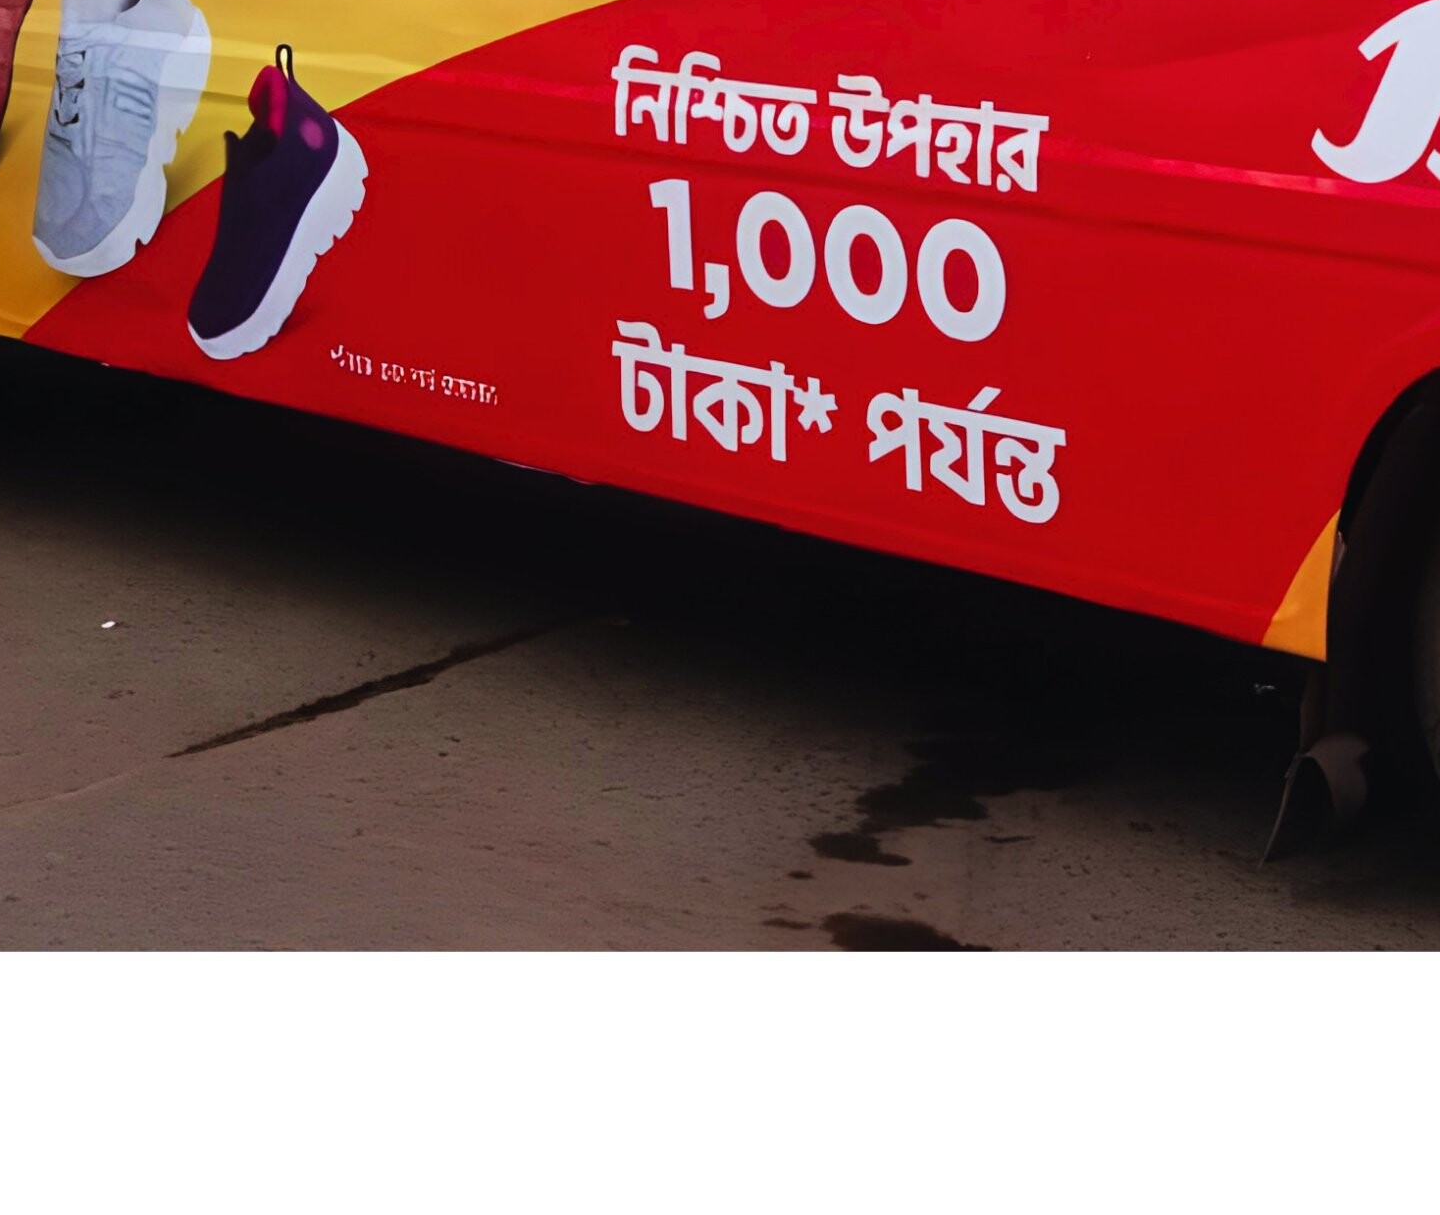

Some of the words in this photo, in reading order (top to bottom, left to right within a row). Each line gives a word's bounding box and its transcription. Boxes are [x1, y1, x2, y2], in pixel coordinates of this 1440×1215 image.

[610, 44, 818, 156] নিশ্চিত
[828, 73, 1050, 193] উপহার
[648, 178, 1007, 343] 1,000
[866, 386, 1067, 524] পর্যন্ত
